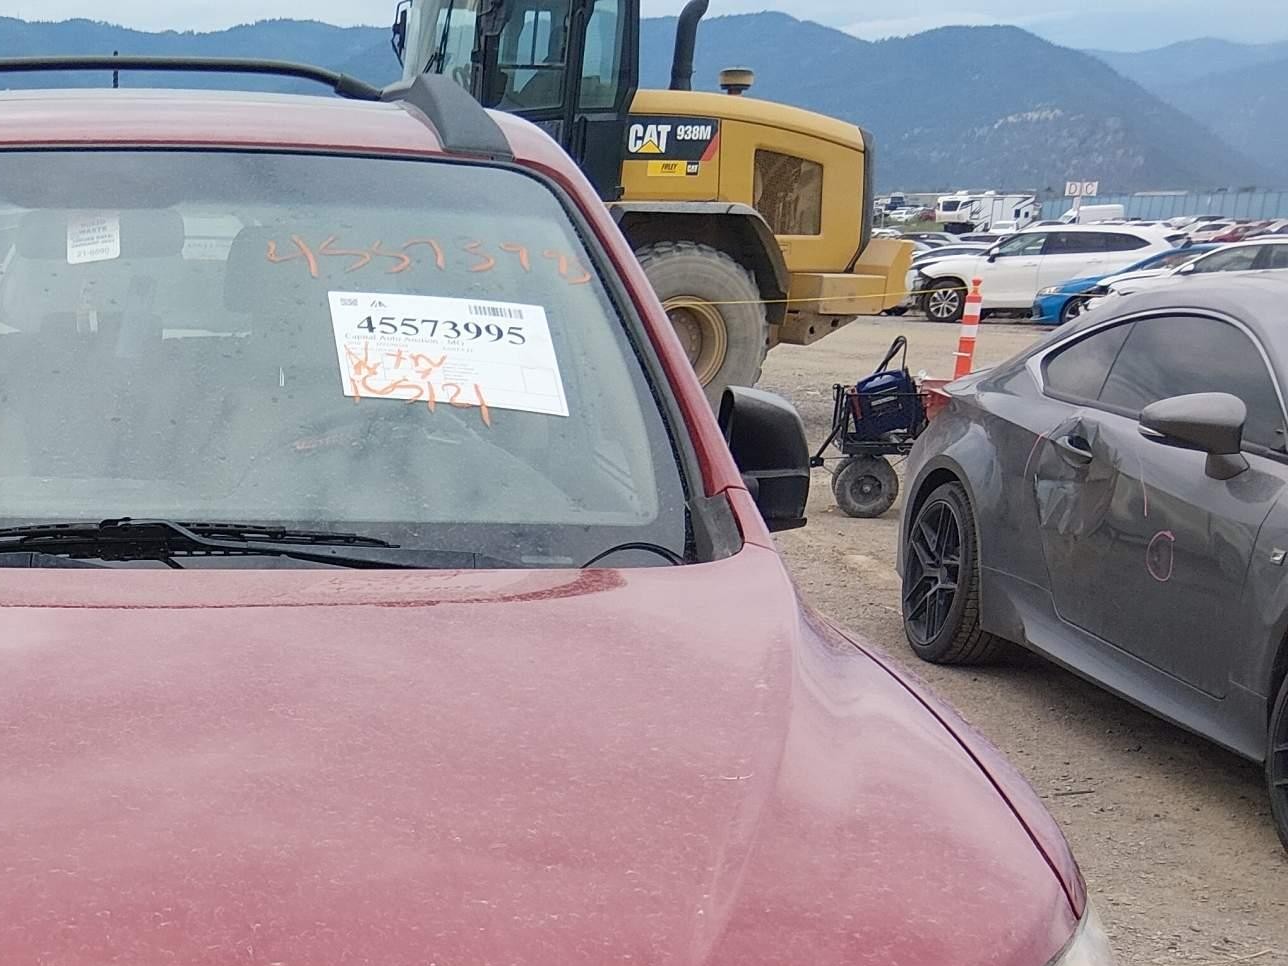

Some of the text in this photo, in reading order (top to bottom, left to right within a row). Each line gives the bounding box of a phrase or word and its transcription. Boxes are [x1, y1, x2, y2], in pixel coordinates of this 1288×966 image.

[628, 123, 712, 154] CAT 938M
[687, 164, 698, 173] CAT
[1069, 183, 1078, 194] D
[356, 315, 527, 346] 45573995
